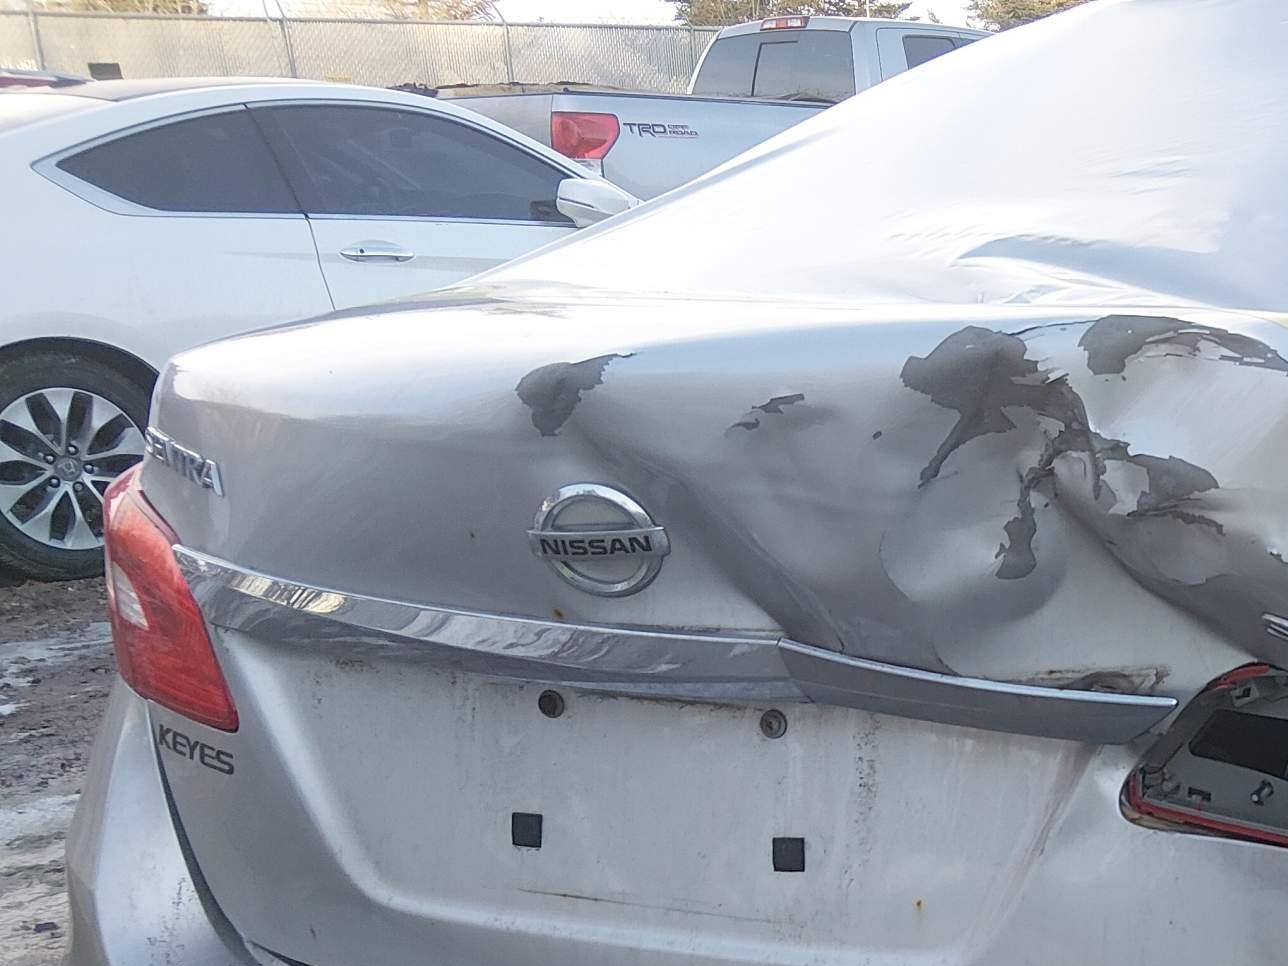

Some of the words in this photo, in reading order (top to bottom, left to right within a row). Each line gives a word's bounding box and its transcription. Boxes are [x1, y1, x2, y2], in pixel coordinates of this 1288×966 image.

[623, 122, 667, 137] TRD
[540, 535, 653, 556] NISSAN
[159, 724, 234, 775] KEYES
